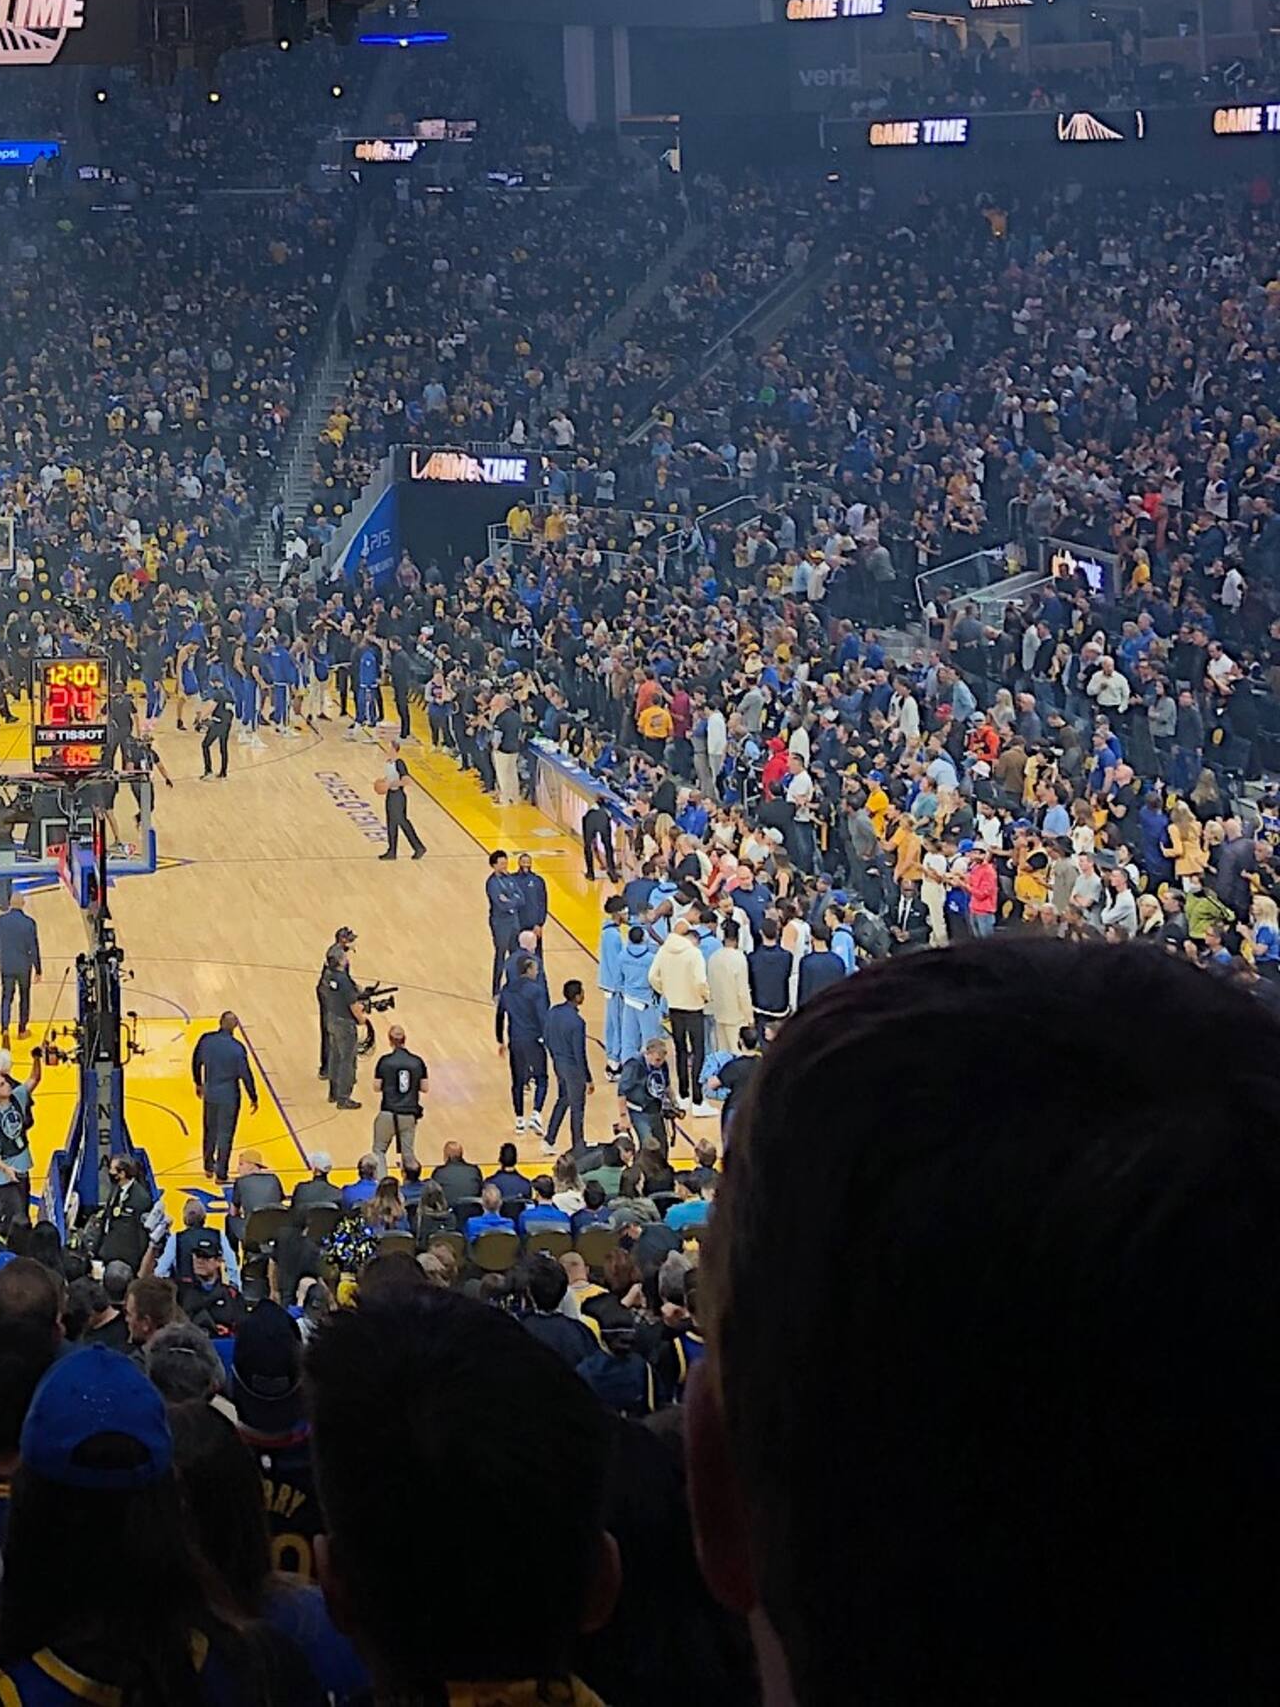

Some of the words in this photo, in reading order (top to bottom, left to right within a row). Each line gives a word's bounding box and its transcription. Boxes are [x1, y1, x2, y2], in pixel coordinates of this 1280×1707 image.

[870, 120, 919, 146] GAME
[923, 118, 967, 143] TIME
[1214, 106, 1262, 134] GAME
[482, 458, 526, 482] TIME
[370, 529, 391, 552] PS5
[45, 665, 98, 686] 12:00
[47, 687, 93, 723] 24
[56, 729, 105, 740] TISSOT
